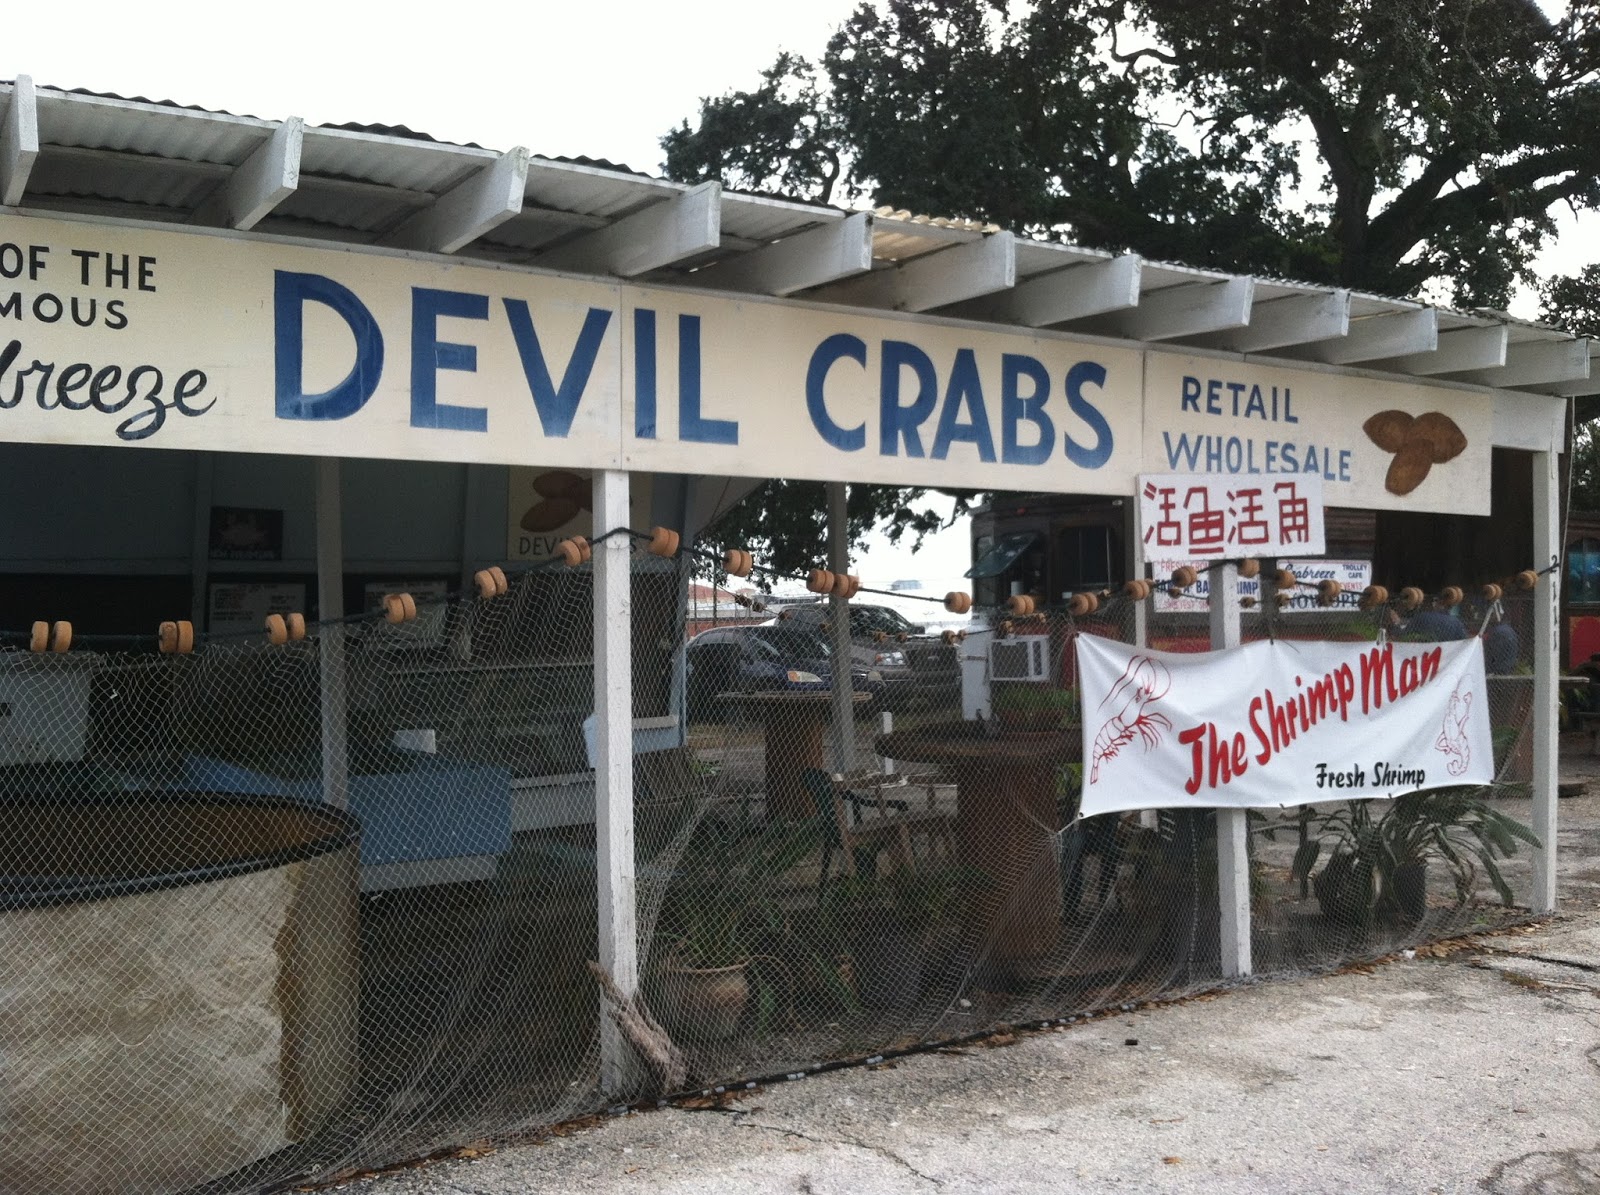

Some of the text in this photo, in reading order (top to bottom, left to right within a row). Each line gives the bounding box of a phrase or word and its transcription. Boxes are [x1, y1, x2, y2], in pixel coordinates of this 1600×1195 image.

[0, 243, 157, 293] OF THE
[273, 268, 1115, 470] DEVIL CRABS
[1181, 375, 1299, 424] RETAIL
[1162, 431, 1352, 482] WHOLESALE
[1196, 580, 1209, 594] BA
[1342, 564, 1368, 572] TROLLEY
[1178, 641, 1443, 796] The Shrimp Man
[1315, 761, 1426, 789] Fresh Shrimp
